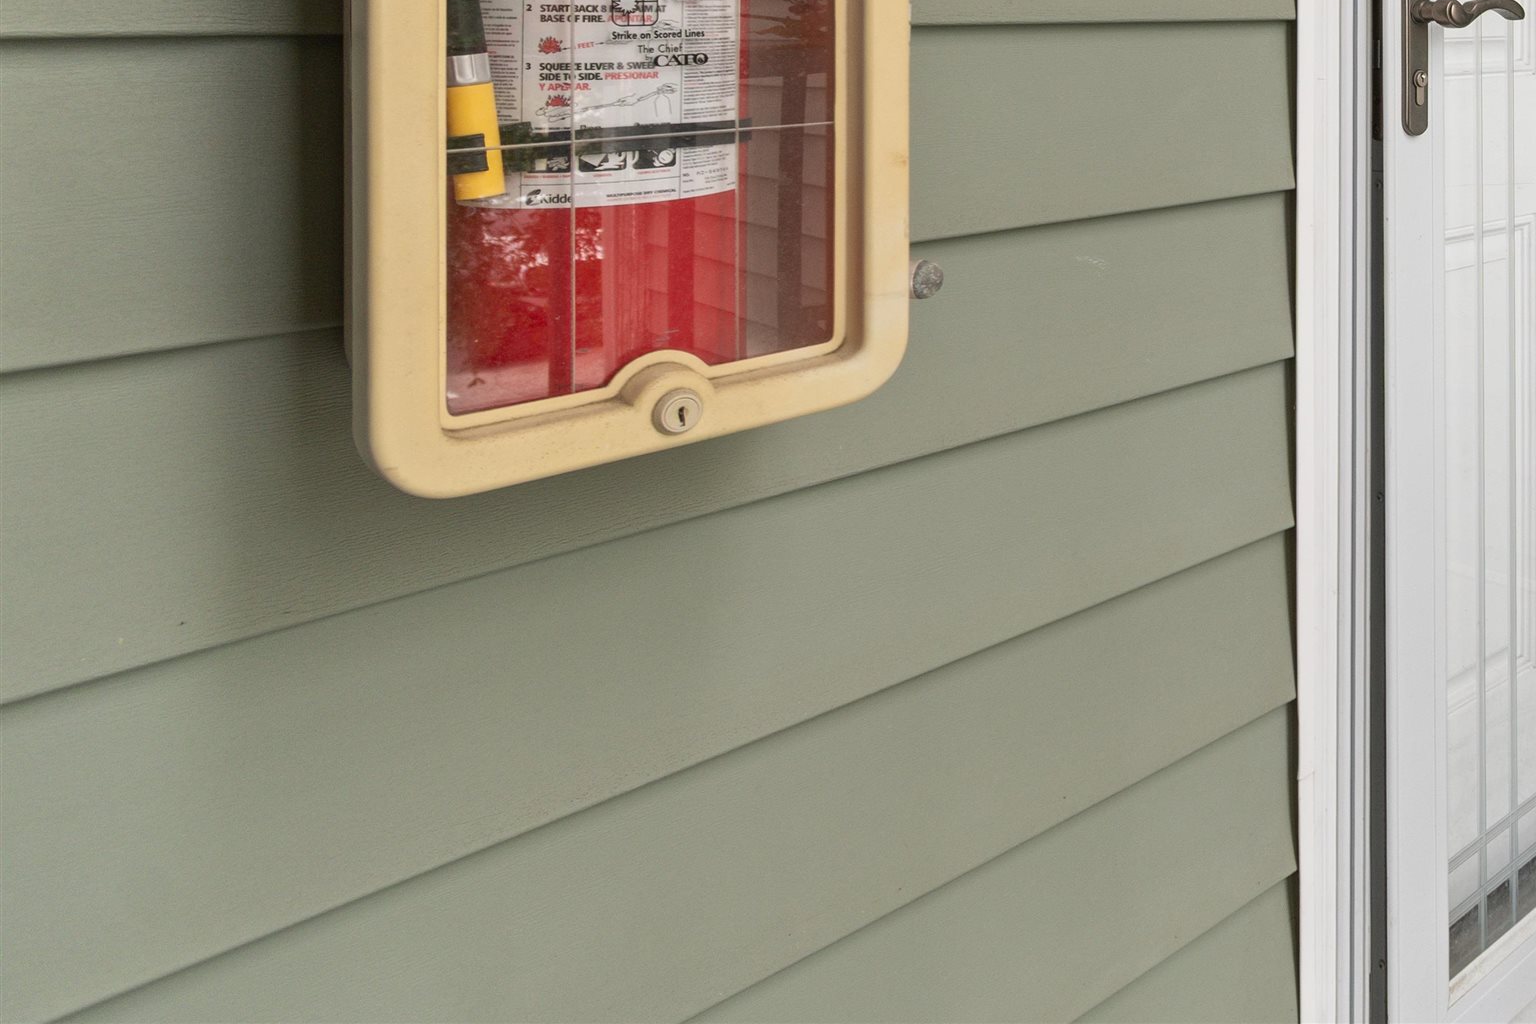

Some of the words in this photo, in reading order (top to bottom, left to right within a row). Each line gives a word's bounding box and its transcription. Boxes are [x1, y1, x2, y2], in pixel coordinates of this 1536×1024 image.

[540, 4, 570, 13] START
[573, 4, 598, 13] BACK
[601, 4, 607, 12] 8
[540, 14, 565, 23] BASE
[582, 14, 605, 23] FIRE.
[612, 31, 637, 40] Strike
[654, 30, 682, 39] Scored
[685, 29, 705, 38] Lines
[577, 41, 594, 49] FEET
[638, 45, 655, 54] The
[658, 43, 684, 53] Chief
[654, 53, 708, 67] CATO
[525, 63, 532, 71] 3
[584, 62, 615, 71] LEVER
[617, 62, 624, 70] &
[539, 73, 565, 81] SIDE
[578, 72, 603, 81] SIDE.
[604, 71, 659, 81] PRESIONAR
